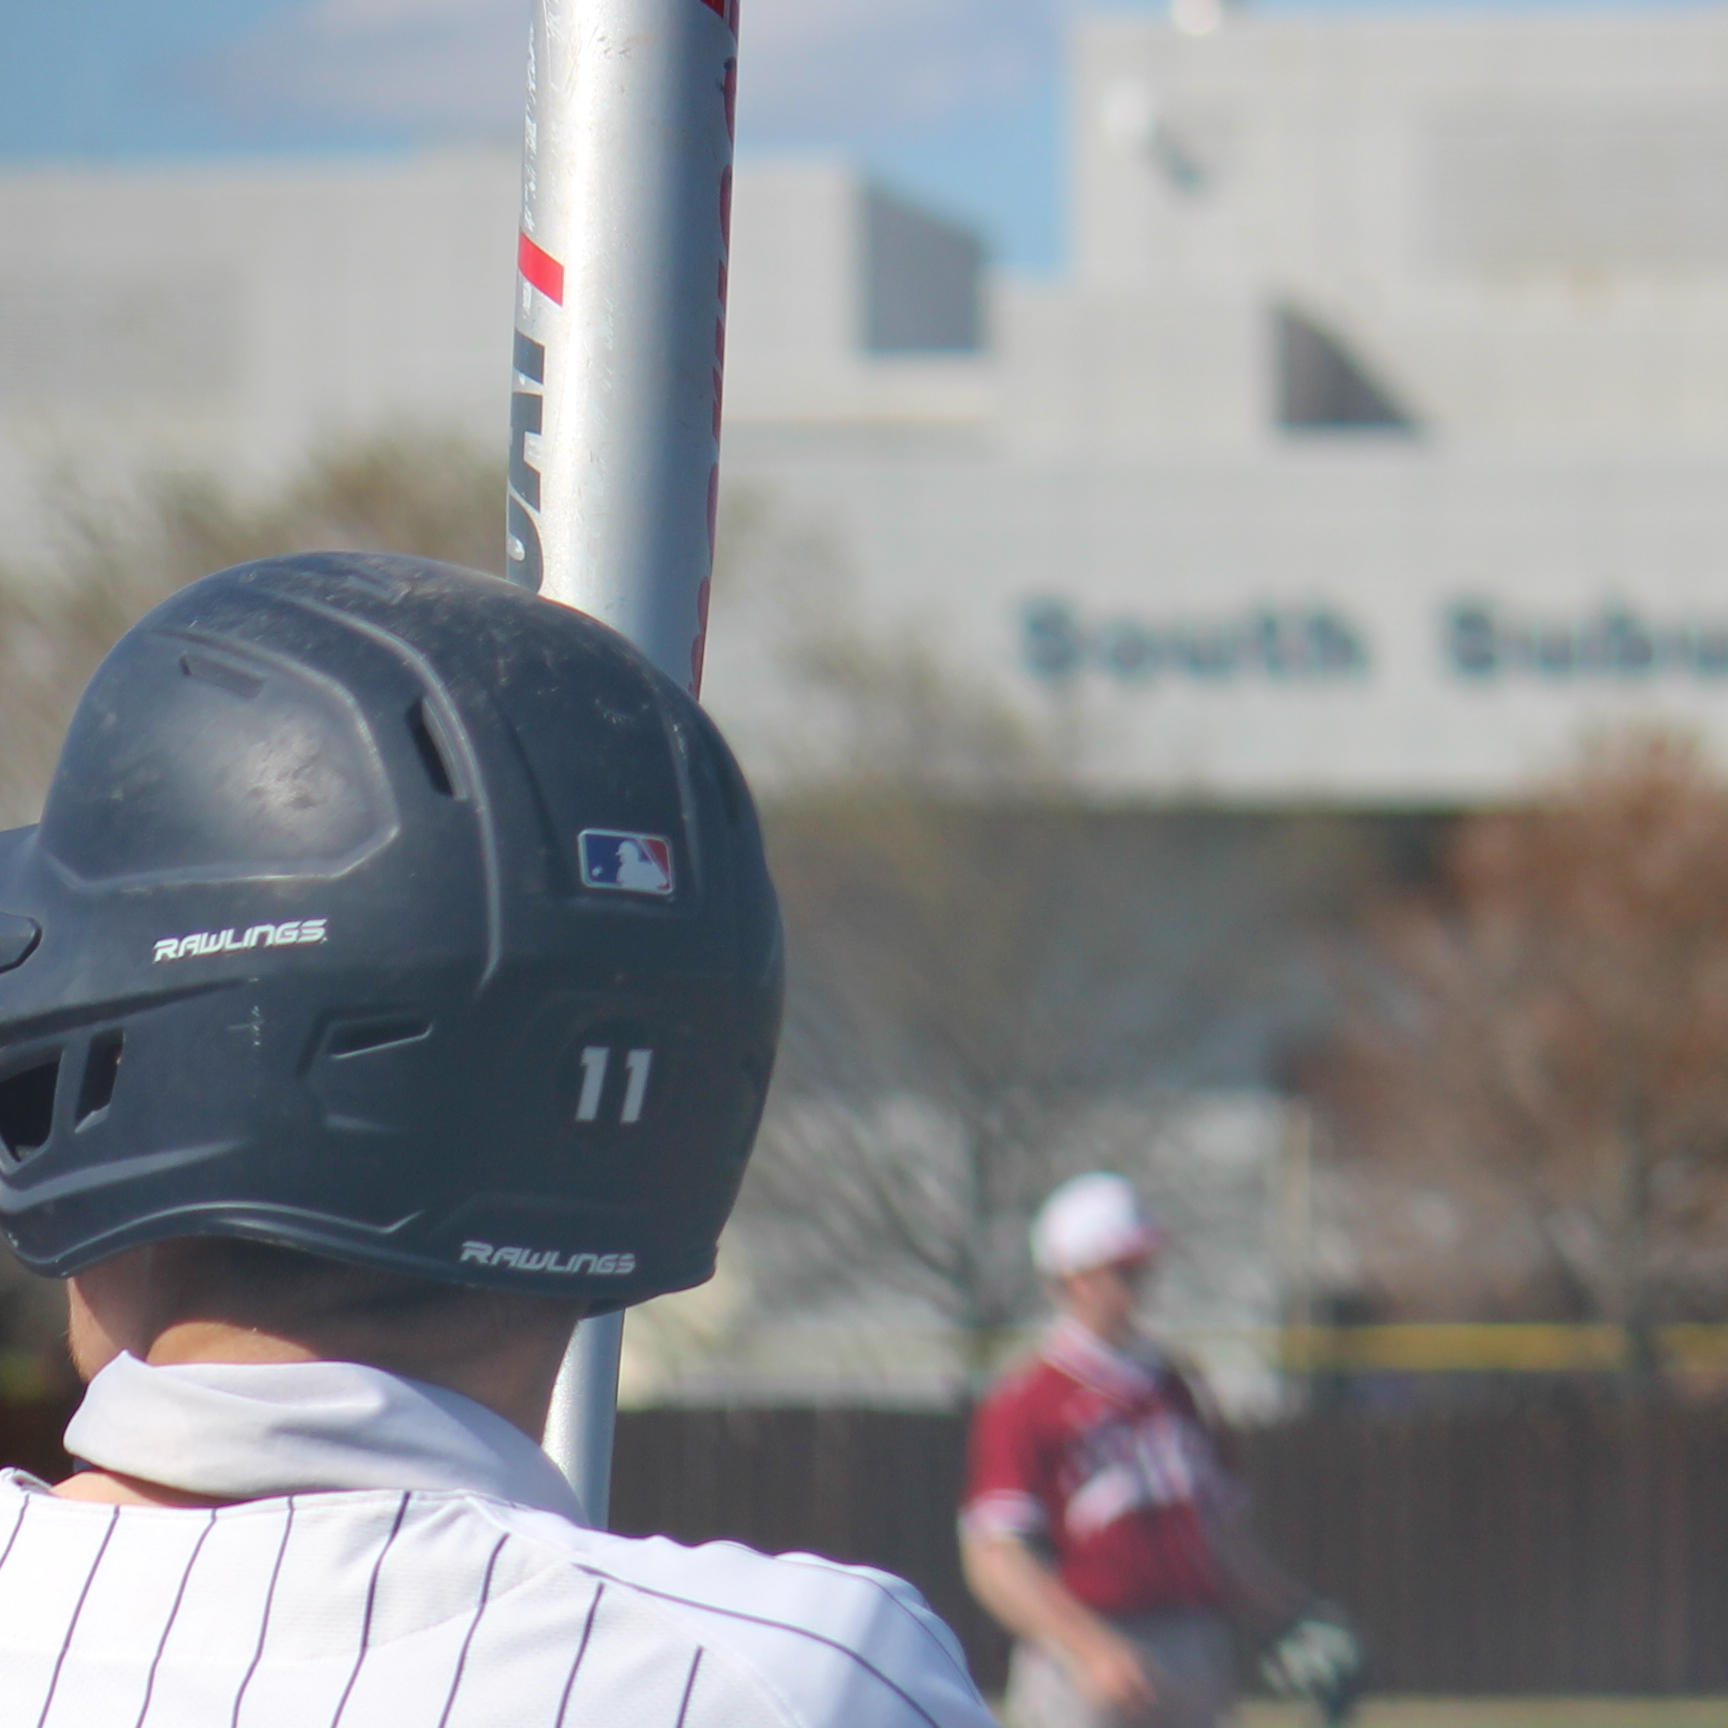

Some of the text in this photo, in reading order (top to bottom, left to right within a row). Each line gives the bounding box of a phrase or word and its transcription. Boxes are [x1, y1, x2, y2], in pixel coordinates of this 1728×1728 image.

[1018, 594, 1371, 684] South
[152, 918, 328, 964] RAWLINGS
[575, 1045, 654, 1124] 11
[459, 1239, 636, 1275] RAWLINGS
